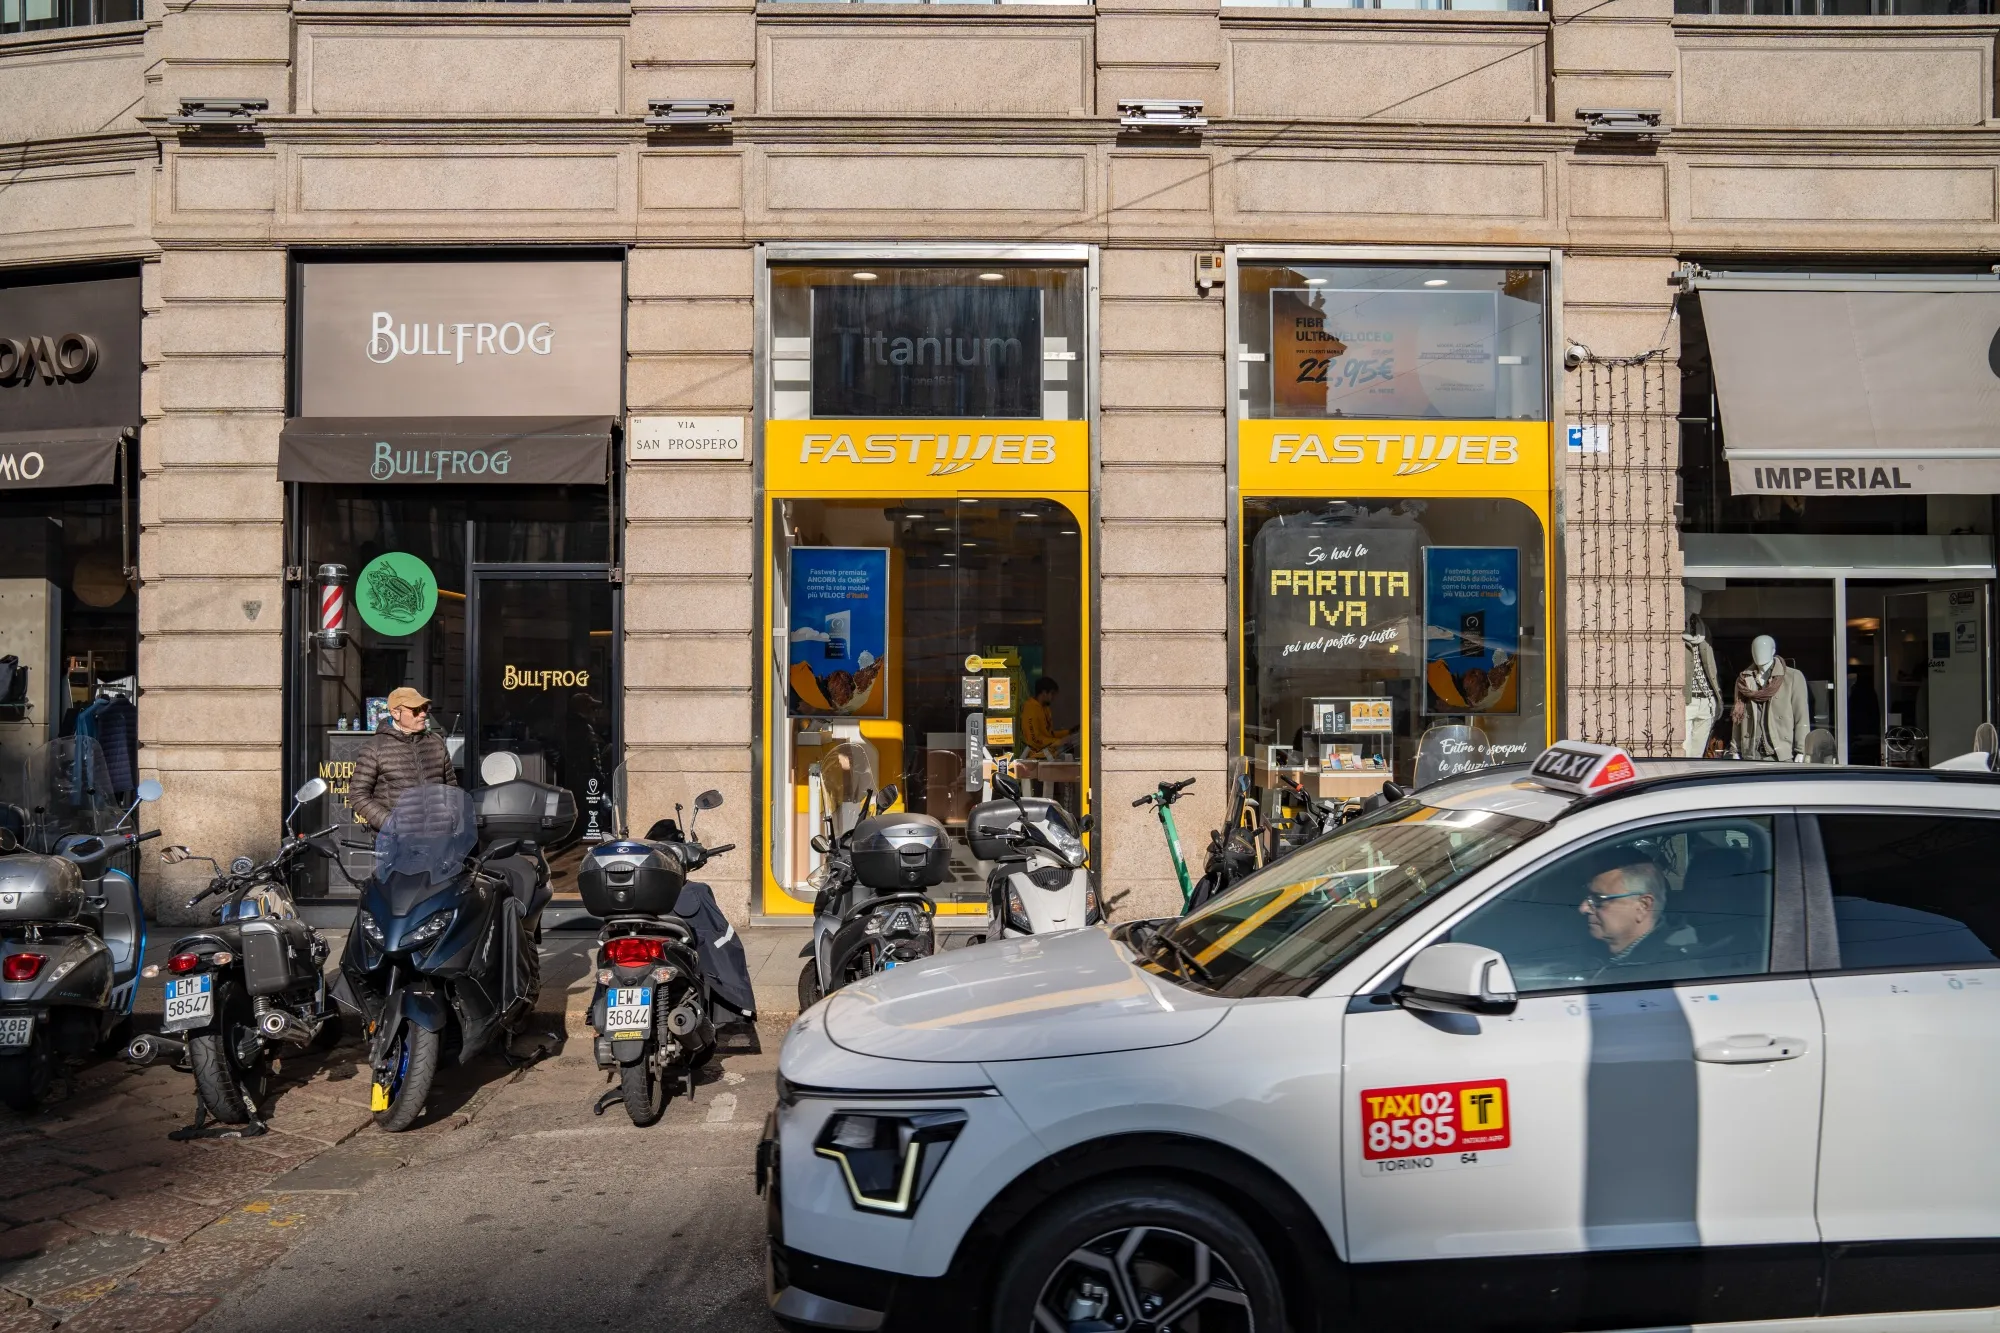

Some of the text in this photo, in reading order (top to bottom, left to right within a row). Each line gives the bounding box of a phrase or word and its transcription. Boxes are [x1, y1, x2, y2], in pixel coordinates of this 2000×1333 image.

[1296, 317, 1331, 328] FIBR
[366, 311, 556, 364] BULLFROG
[1296, 331, 1381, 342] ULTRAVELOCE
[1296, 357, 1394, 388] 22,95€
[678, 421, 695, 429] VIA
[636, 438, 738, 450] SAN PROSPERO
[800, 433, 1056, 476] FASTWEB
[1269, 433, 1519, 476] FASTWEB
[370, 441, 512, 481] BULLFROG
[1754, 466, 1912, 490] IMPERIAL
[1305, 543, 1369, 566] Se hai la
[808, 576, 837, 584] ANCORA
[838, 569, 867, 577] premiata
[1271, 569, 1410, 597] PARTITA
[1309, 600, 1367, 626] IVA
[1323, 631, 1357, 653] posto
[1359, 626, 1399, 649] giusto
[502, 664, 590, 691] BULLFROG
[1440, 738, 1527, 757] Entra e scopri
[319, 762, 357, 778] MODER
[1439, 760, 1450, 771] le
[1538, 751, 1596, 779] TAXI
[177, 979, 193, 995] EM
[618, 990, 634, 1005] EW
[168, 995, 209, 1017] 58547
[608, 1009, 648, 1026] 36844
[1368, 1115, 1456, 1152] 8585
[1377, 1153, 1478, 1172] TORINO 64
